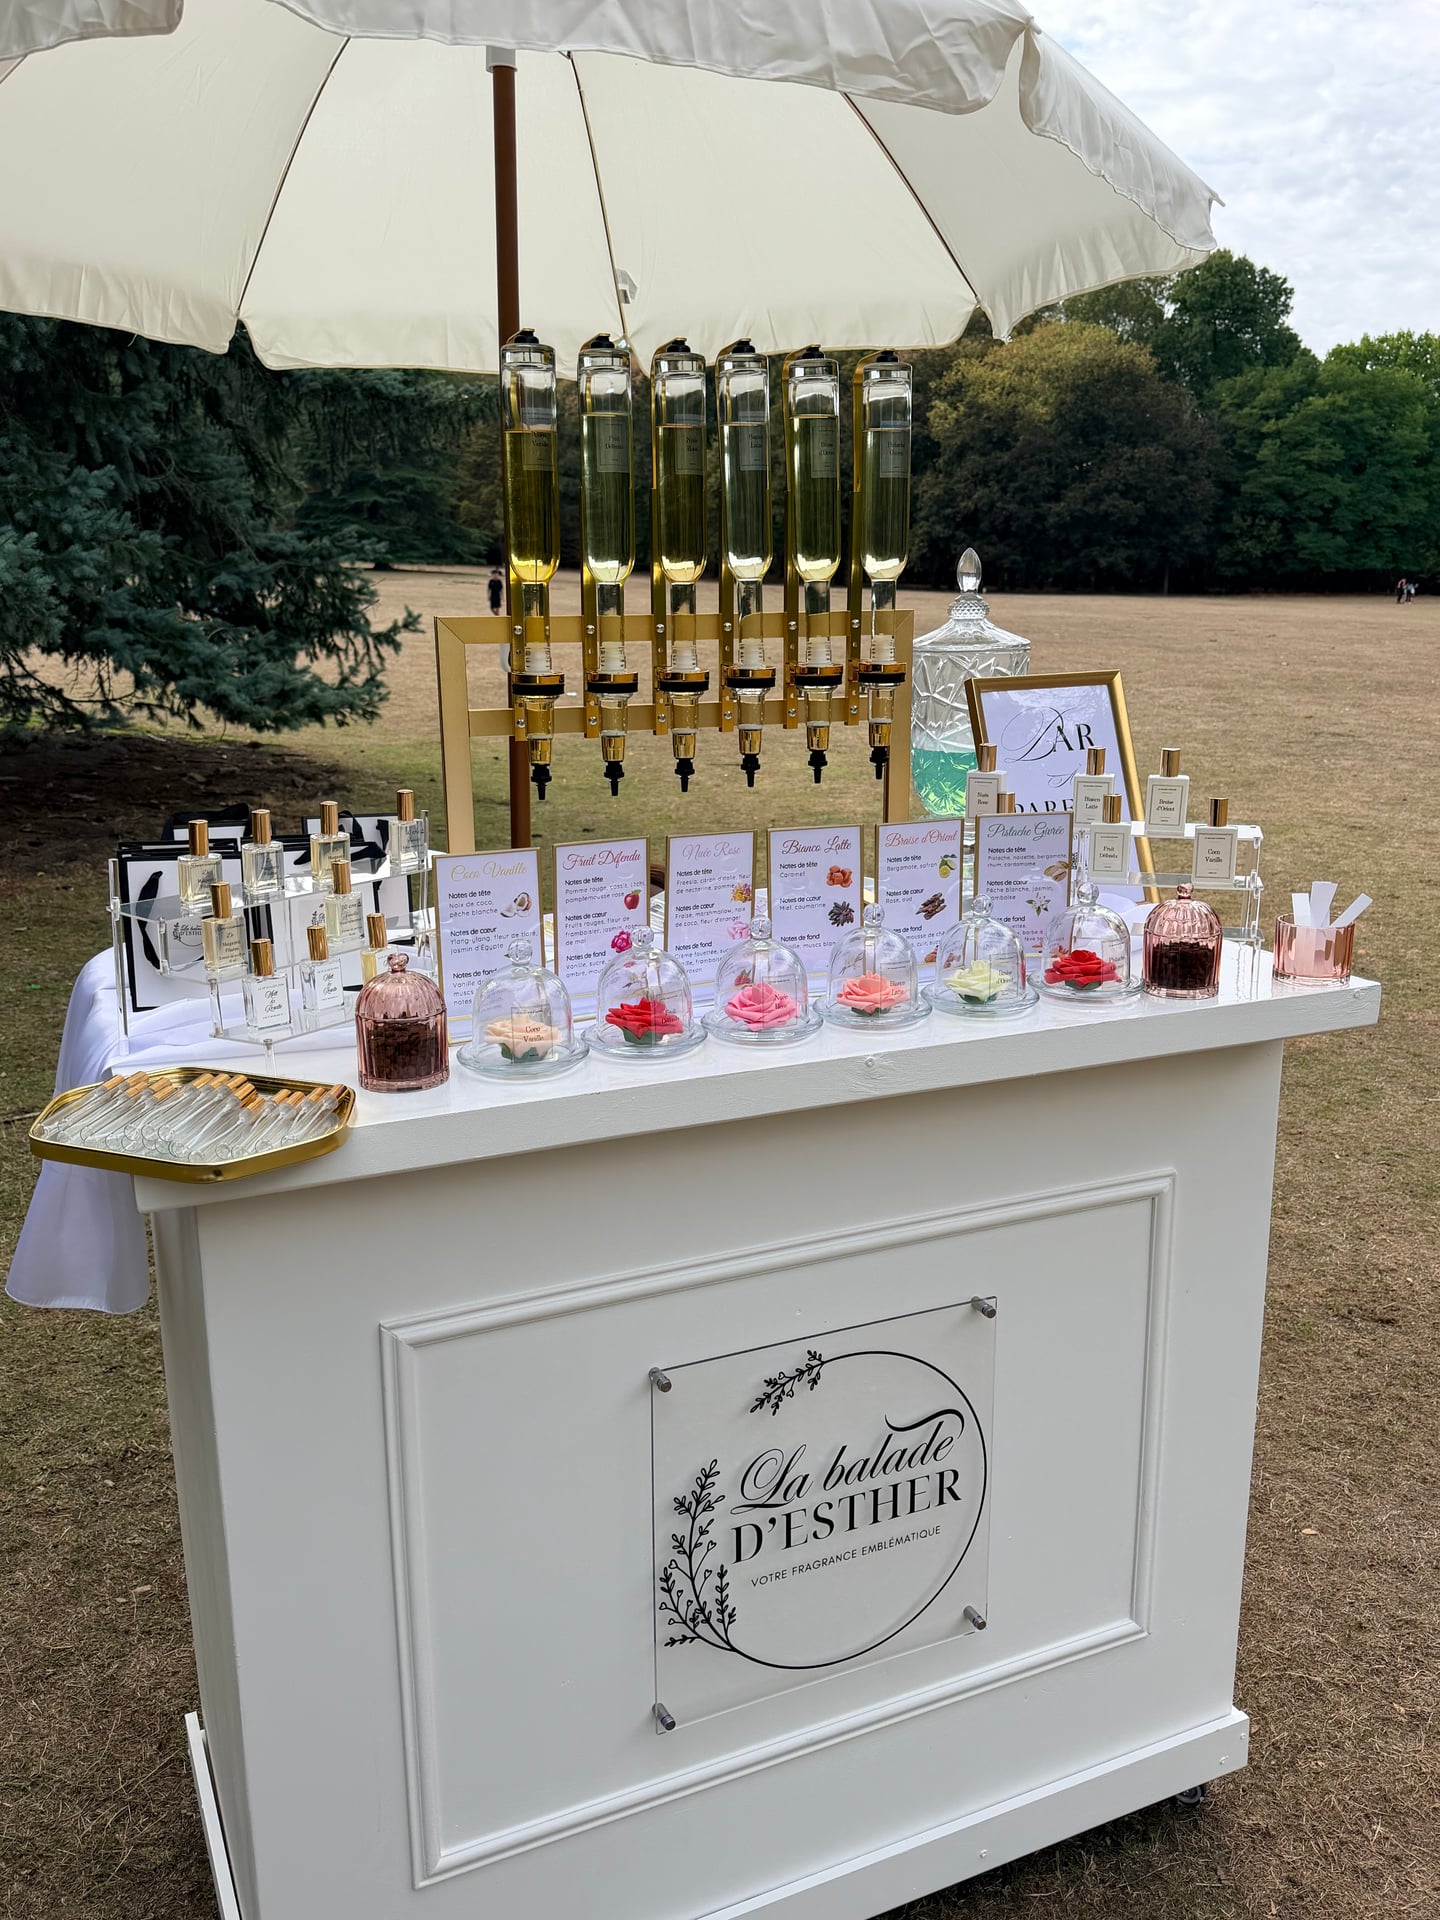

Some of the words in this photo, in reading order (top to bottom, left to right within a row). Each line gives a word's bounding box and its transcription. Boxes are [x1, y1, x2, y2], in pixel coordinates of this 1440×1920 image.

[884, 832, 920, 848] Braise
[921, 828, 959, 844] d'Orient
[987, 823, 1032, 838] Pistache
[1032, 821, 1065, 842] Givrée
[713, 841, 741, 857] Rose
[781, 839, 821, 855] Bianco
[823, 835, 852, 855] Latte
[562, 853, 597, 871] Fruit
[597, 849, 642, 869] Défendu
[450, 864, 480, 882] Coco
[482, 860, 527, 879] Vanille
[448, 892, 468, 900] Notes
[468, 890, 477, 898] de
[478, 889, 492, 897] tête
[465, 900, 475, 908] de
[449, 910, 470, 919] pêche
[471, 907, 498, 916] blanche
[450, 946, 473, 955] jasmin
[592, 950, 607, 958] fond
[730, 1443, 814, 1515] La
[822, 1408, 965, 1492] balade
[730, 1467, 963, 1565] D'ESTHER
[750, 1569, 788, 1588] VOTRE
[791, 1549, 858, 1576] FRAGRANCE
[860, 1525, 942, 1557] EMBLÉMATIQUE
